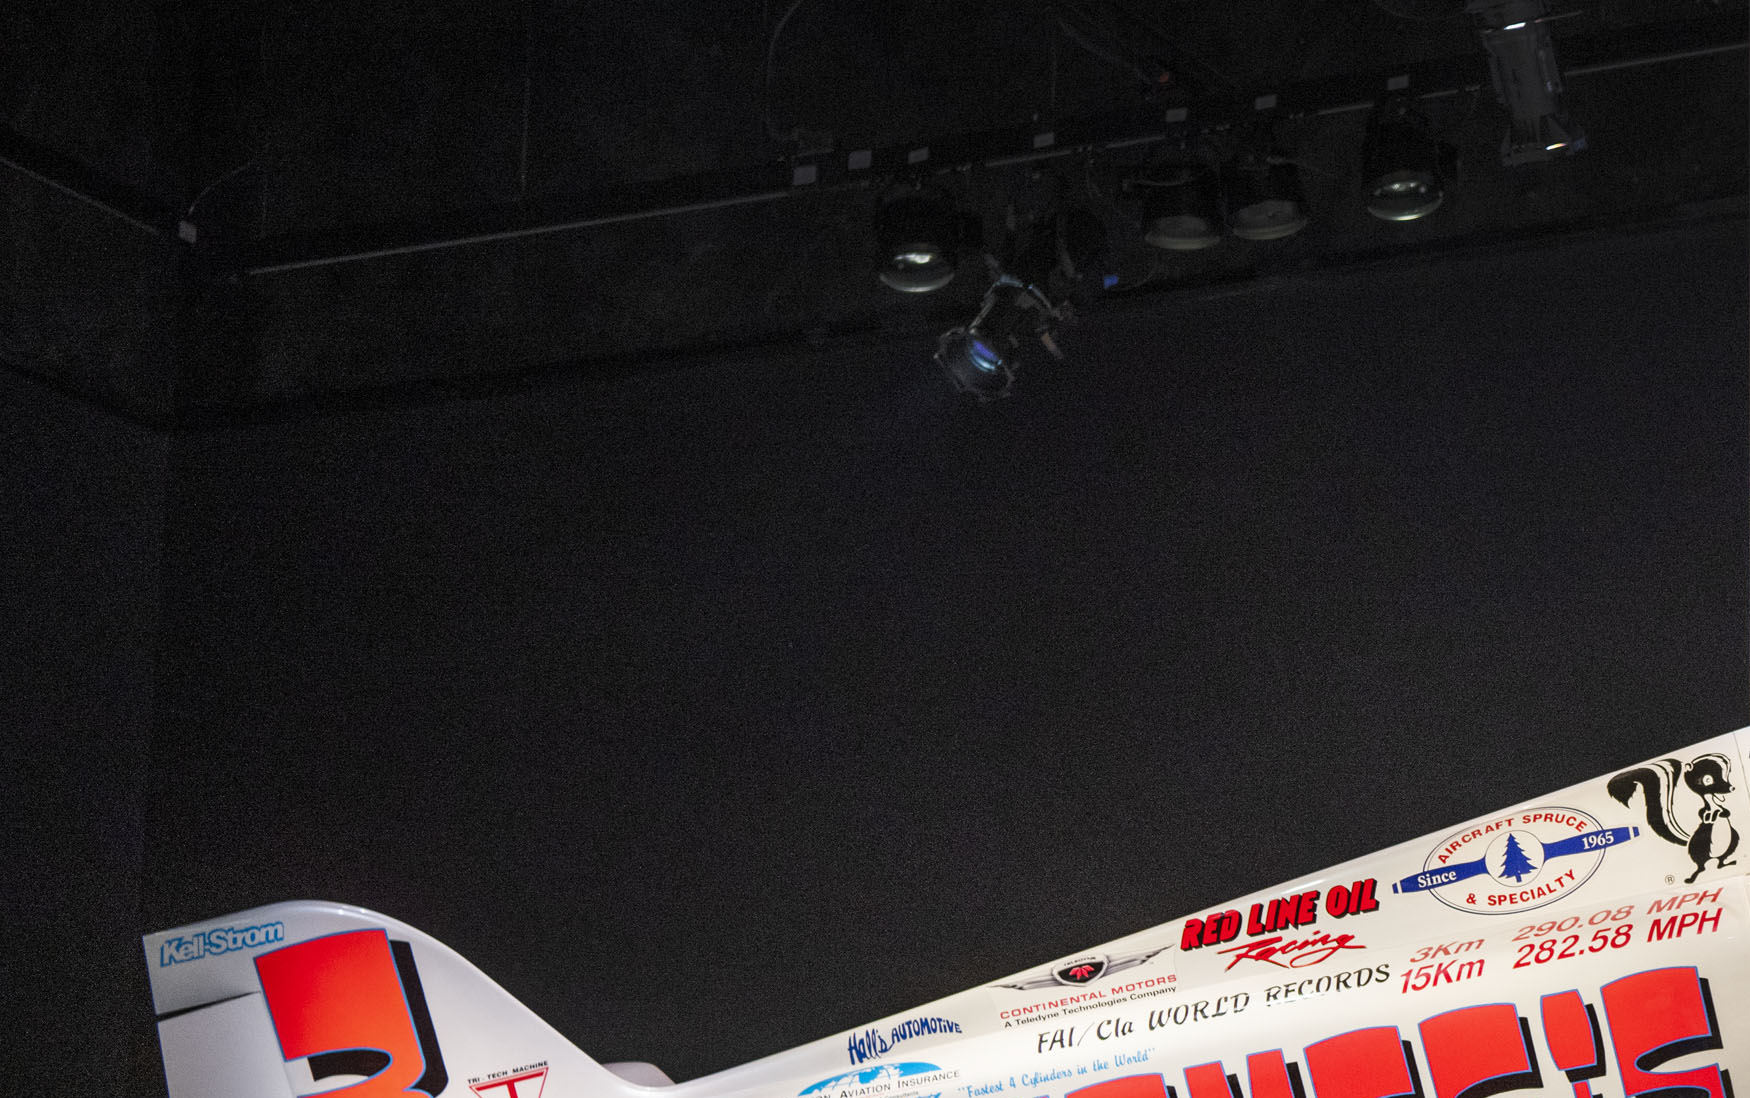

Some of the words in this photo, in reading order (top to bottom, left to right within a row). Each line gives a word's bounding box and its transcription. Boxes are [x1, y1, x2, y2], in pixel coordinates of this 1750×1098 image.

[1417, 868, 1458, 889] Since
[1581, 831, 1615, 850] 1965
[1437, 817, 1514, 865] AIRCRAFT
[1521, 813, 1588, 833] SPRUCE
[1465, 892, 1478, 905] &
[1487, 869, 1577, 906] SPECIALTY
[1180, 909, 1242, 951] RED
[1246, 888, 1321, 938] LINE
[1325, 877, 1380, 918] OIL
[1409, 937, 1486, 964] 3Km
[1511, 905, 1635, 942] 290.08
[1646, 887, 1725, 916] MPH
[161, 921, 285, 968] Kell-Strom
[1217, 930, 1368, 973] Racing
[1400, 958, 1486, 994] 15Km
[1512, 923, 1635, 970] 282.58
[1646, 907, 1724, 944] MPH
[1000, 990, 1107, 1020] CONTINENTAL
[1111, 973, 1178, 996] MOTORS
[1004, 1021, 1012, 1029] A
[1015, 1010, 1060, 1027] Teledyne
[1061, 996, 1128, 1016] Technologies
[1129, 986, 1178, 1003] Company
[1148, 990, 1250, 1033] WORLD
[1263, 963, 1391, 1008] RECORDS
[512, 1060, 549, 1075] MACHINE
[840, 1083, 892, 1098] AVIATION
[897, 1069, 960, 1089] INSURANCE
[1009, 1076, 1017, 1089] 4
[1021, 1067, 1073, 1089] Cylinders
[1077, 1064, 1088, 1075] in
[1092, 1059, 1110, 1072] the
